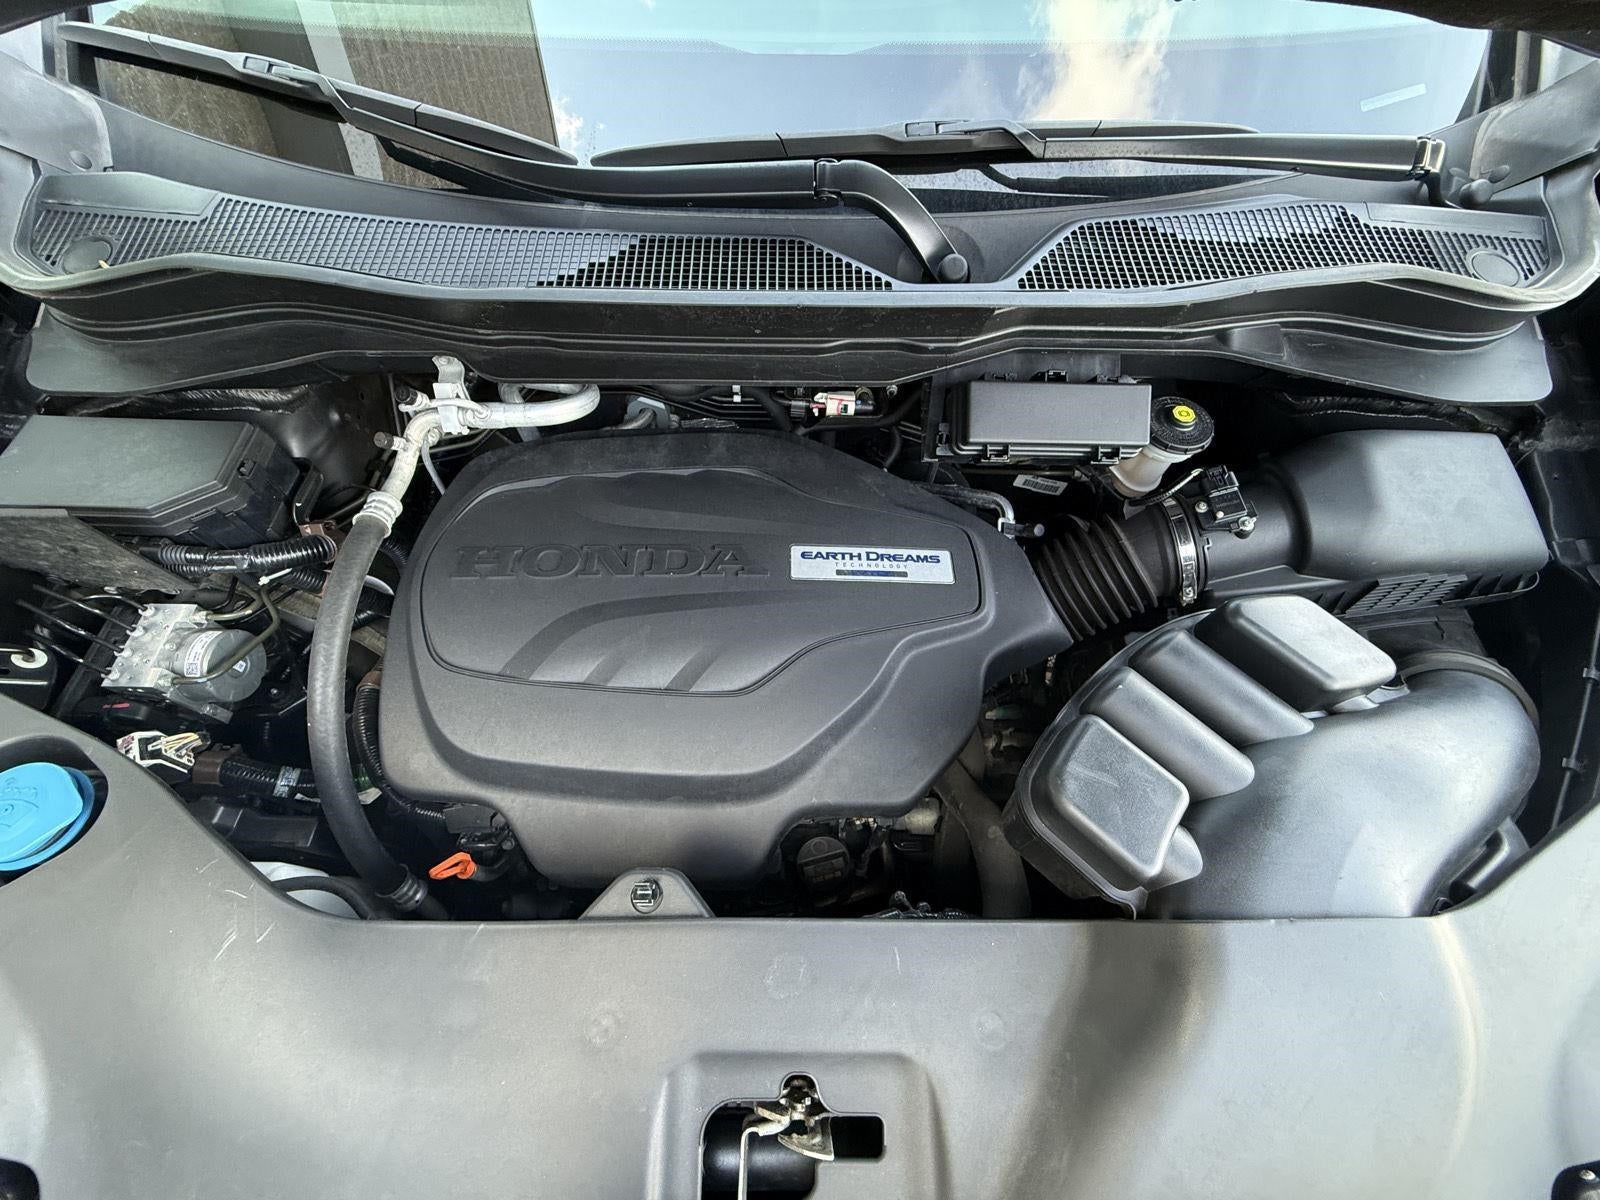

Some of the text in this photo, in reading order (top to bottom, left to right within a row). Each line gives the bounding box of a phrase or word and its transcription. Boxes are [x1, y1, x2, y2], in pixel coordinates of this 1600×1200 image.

[451, 543, 770, 580] HONDA
[800, 551, 941, 564] EARTH DREAMS
[835, 561, 909, 569] TECHNOLOGY
